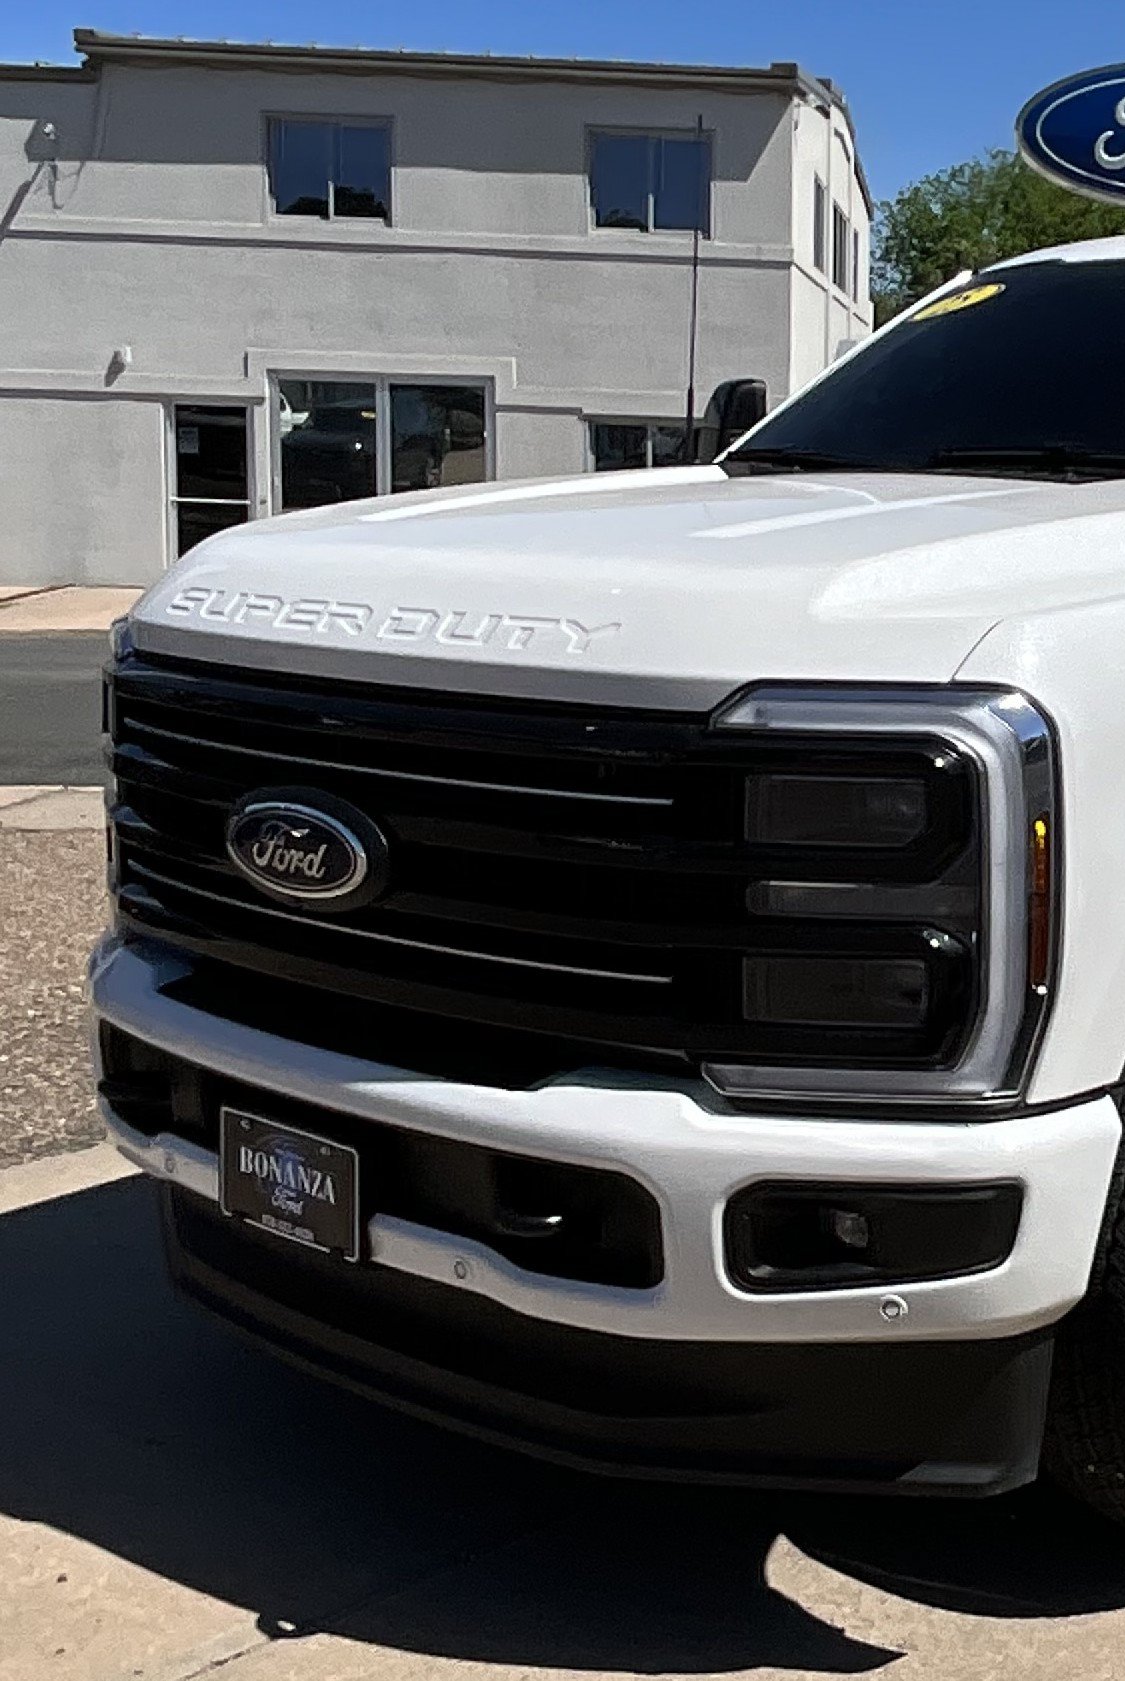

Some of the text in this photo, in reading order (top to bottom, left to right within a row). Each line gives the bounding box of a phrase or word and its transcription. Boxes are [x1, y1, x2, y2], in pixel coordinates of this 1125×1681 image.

[166, 587, 621, 654] SUPER DUTY
[252, 820, 327, 878] Ford
[239, 1146, 335, 1205] BONANZA
